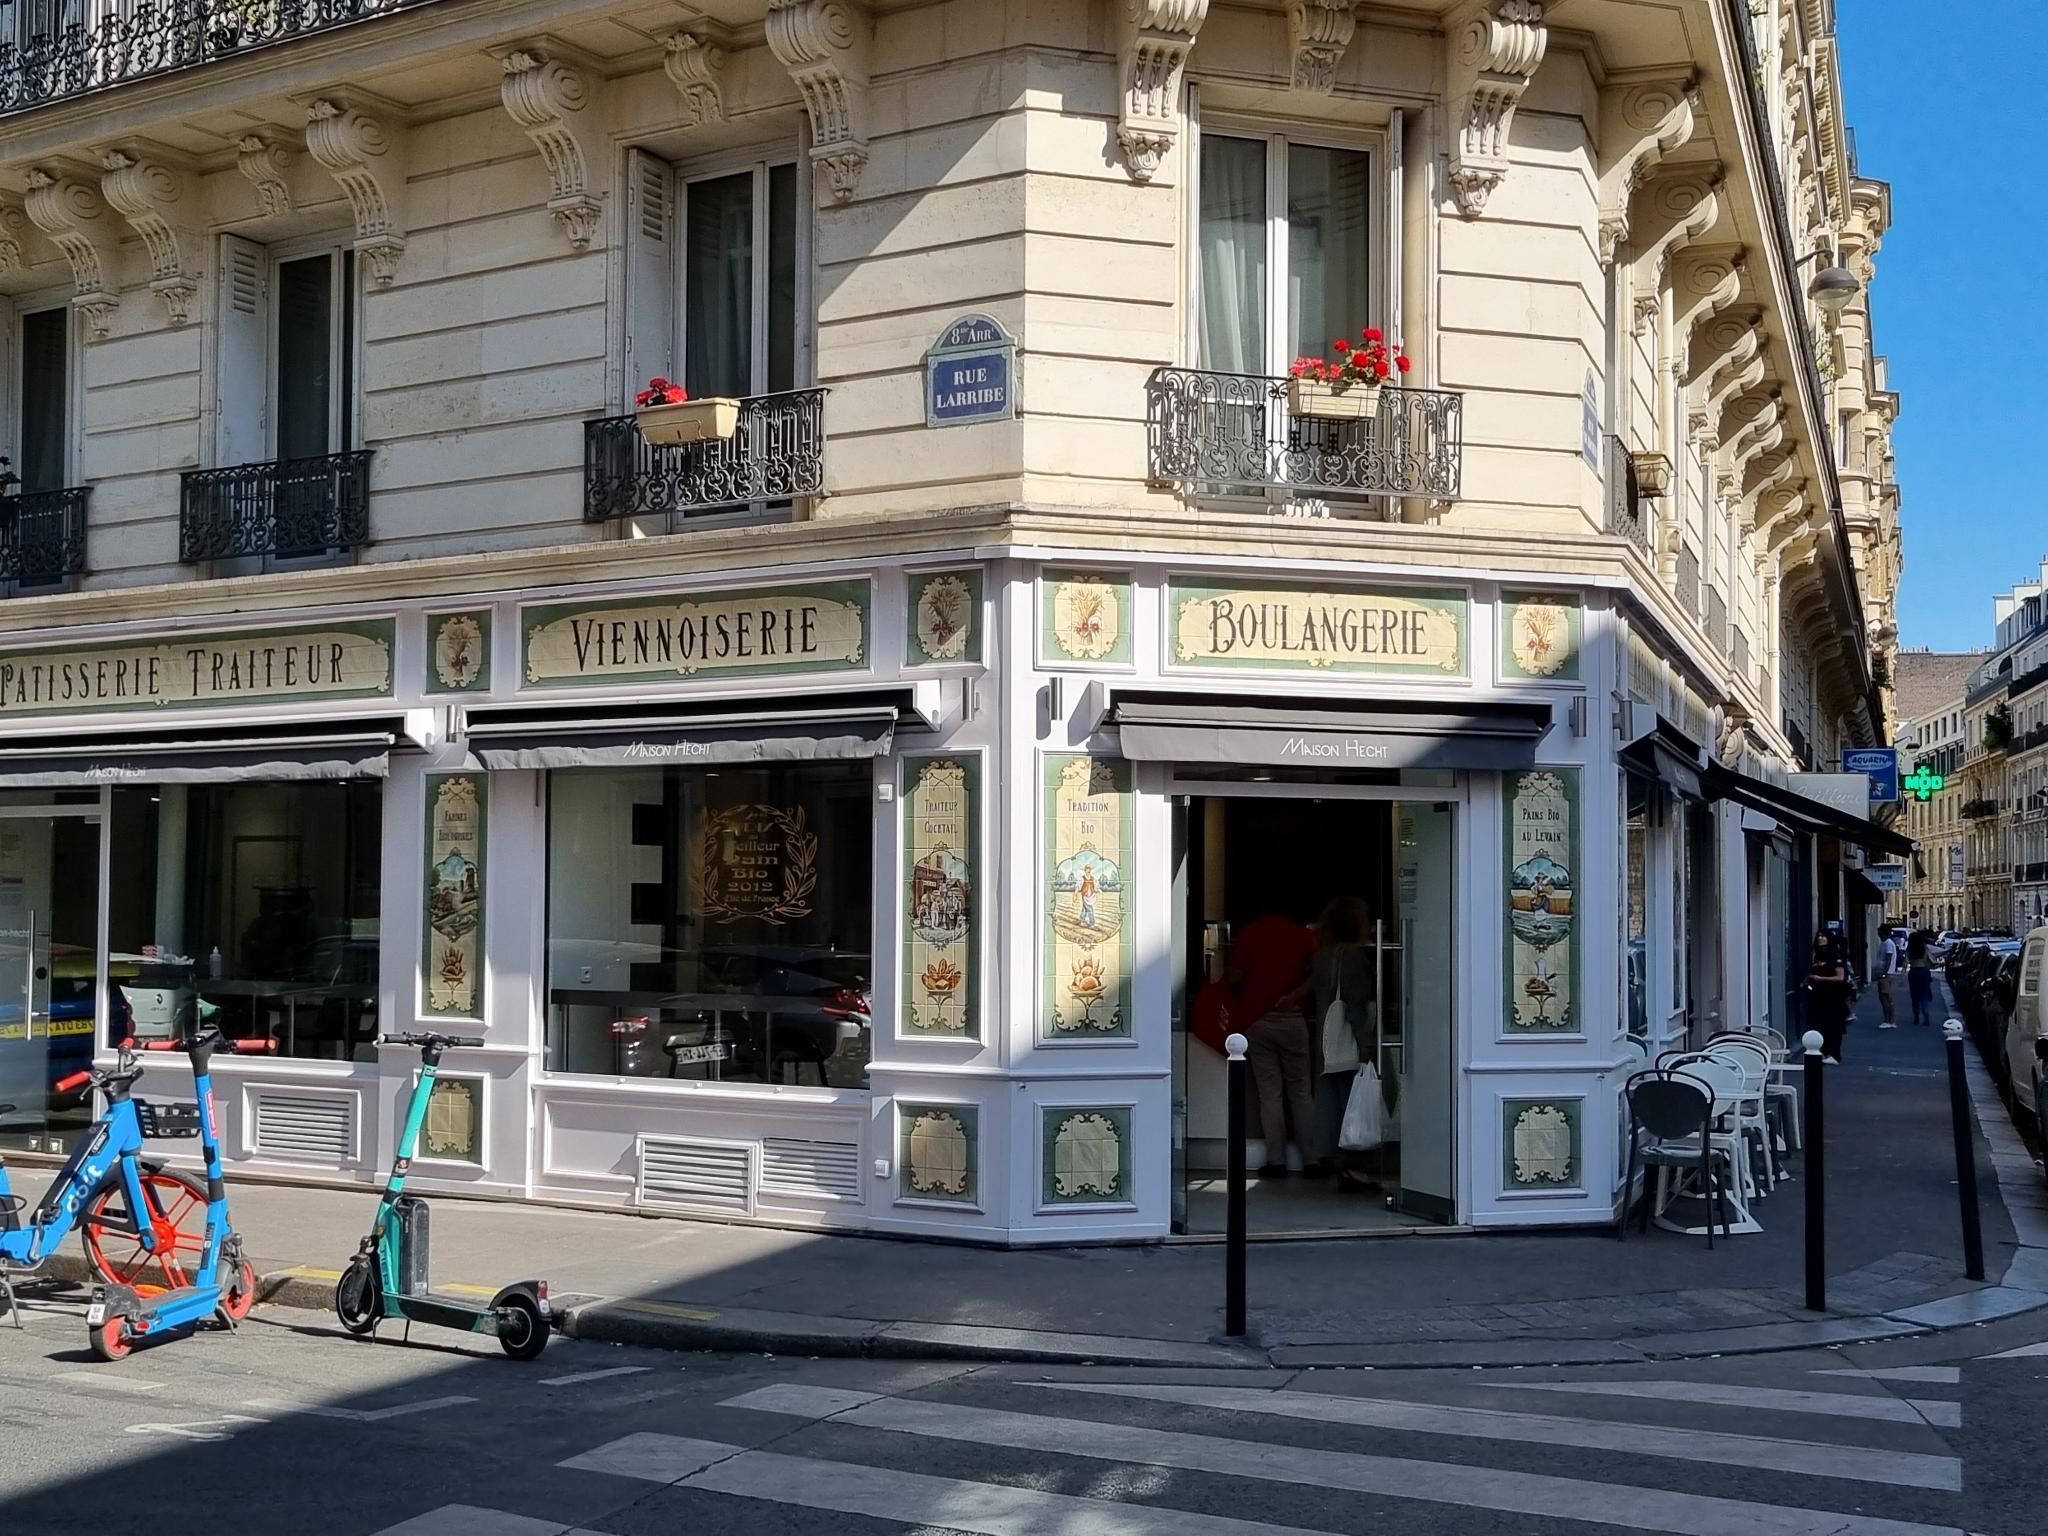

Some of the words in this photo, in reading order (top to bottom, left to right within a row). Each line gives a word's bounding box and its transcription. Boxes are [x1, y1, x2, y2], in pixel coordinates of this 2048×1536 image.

[953, 367, 987, 386] RUE
[936, 387, 1004, 409] LARRIBE
[1209, 599, 1428, 655] BOULANGERIE
[571, 607, 818, 671] VIENNOISERIE
[0, 656, 161, 708] PATISSERIE
[187, 643, 344, 696] TRAITEUR
[623, 740, 671, 757] MAISON
[674, 738, 711, 756] HECHT
[1280, 738, 1340, 757] MAISON
[1345, 739, 1387, 758] HECHT
[1905, 776, 1942, 789] MOD
[925, 799, 958, 813] TRAITEUR
[1067, 799, 1109, 813] TRADITION
[1522, 808, 1544, 821] PAINS
[1548, 809, 1560, 821] BIO
[924, 821, 958, 834] COCKTAIL
[1081, 821, 1095, 834] BIO
[1522, 831, 1532, 842] AU
[1535, 829, 1561, 842] LEVAIN
